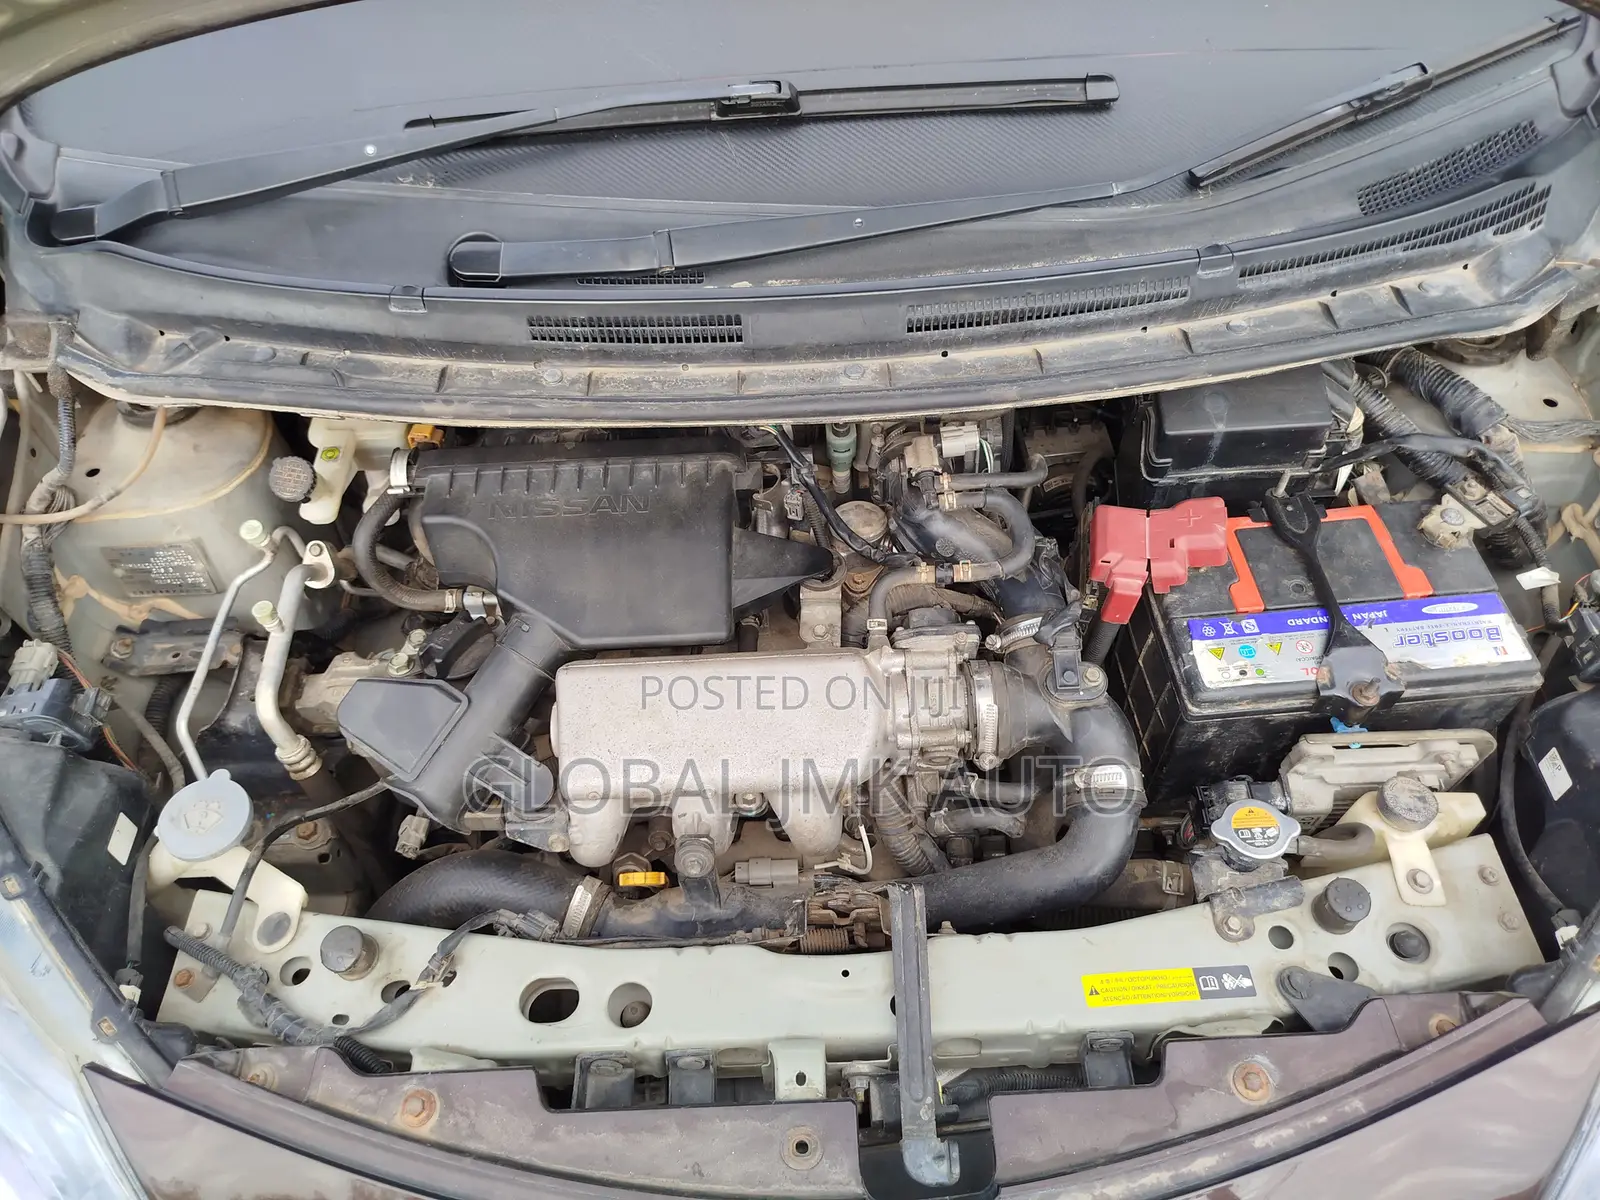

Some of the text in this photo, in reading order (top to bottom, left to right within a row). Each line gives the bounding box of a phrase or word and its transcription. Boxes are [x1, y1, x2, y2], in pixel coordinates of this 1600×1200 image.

[488, 494, 650, 519] NISSAN
[1352, 609, 1388, 621] JAPAN
[1393, 625, 1502, 648] Booster
[1100, 986, 1127, 994] CAUTION
